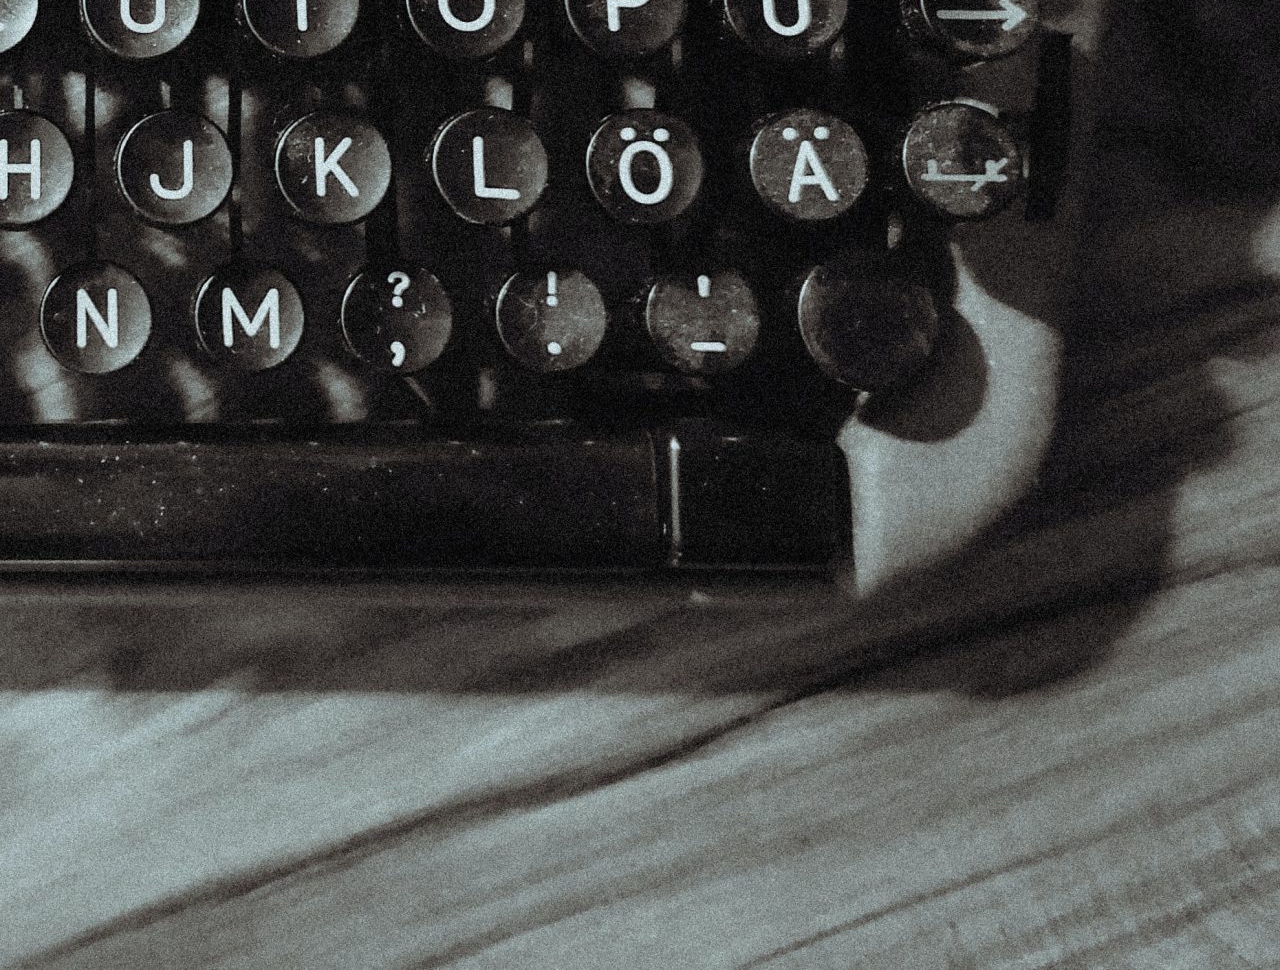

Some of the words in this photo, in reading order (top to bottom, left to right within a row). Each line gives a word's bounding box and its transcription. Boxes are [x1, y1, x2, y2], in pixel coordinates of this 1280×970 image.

[149, 139, 194, 201] J
[314, 136, 360, 199] K
[472, 136, 520, 200] L
[618, 126, 674, 205] Ö
[781, 126, 841, 203] Ä
[76, 287, 119, 349] N
[220, 286, 281, 349] M
[387, 271, 411, 308] ?
[545, 270, 559, 308] !
